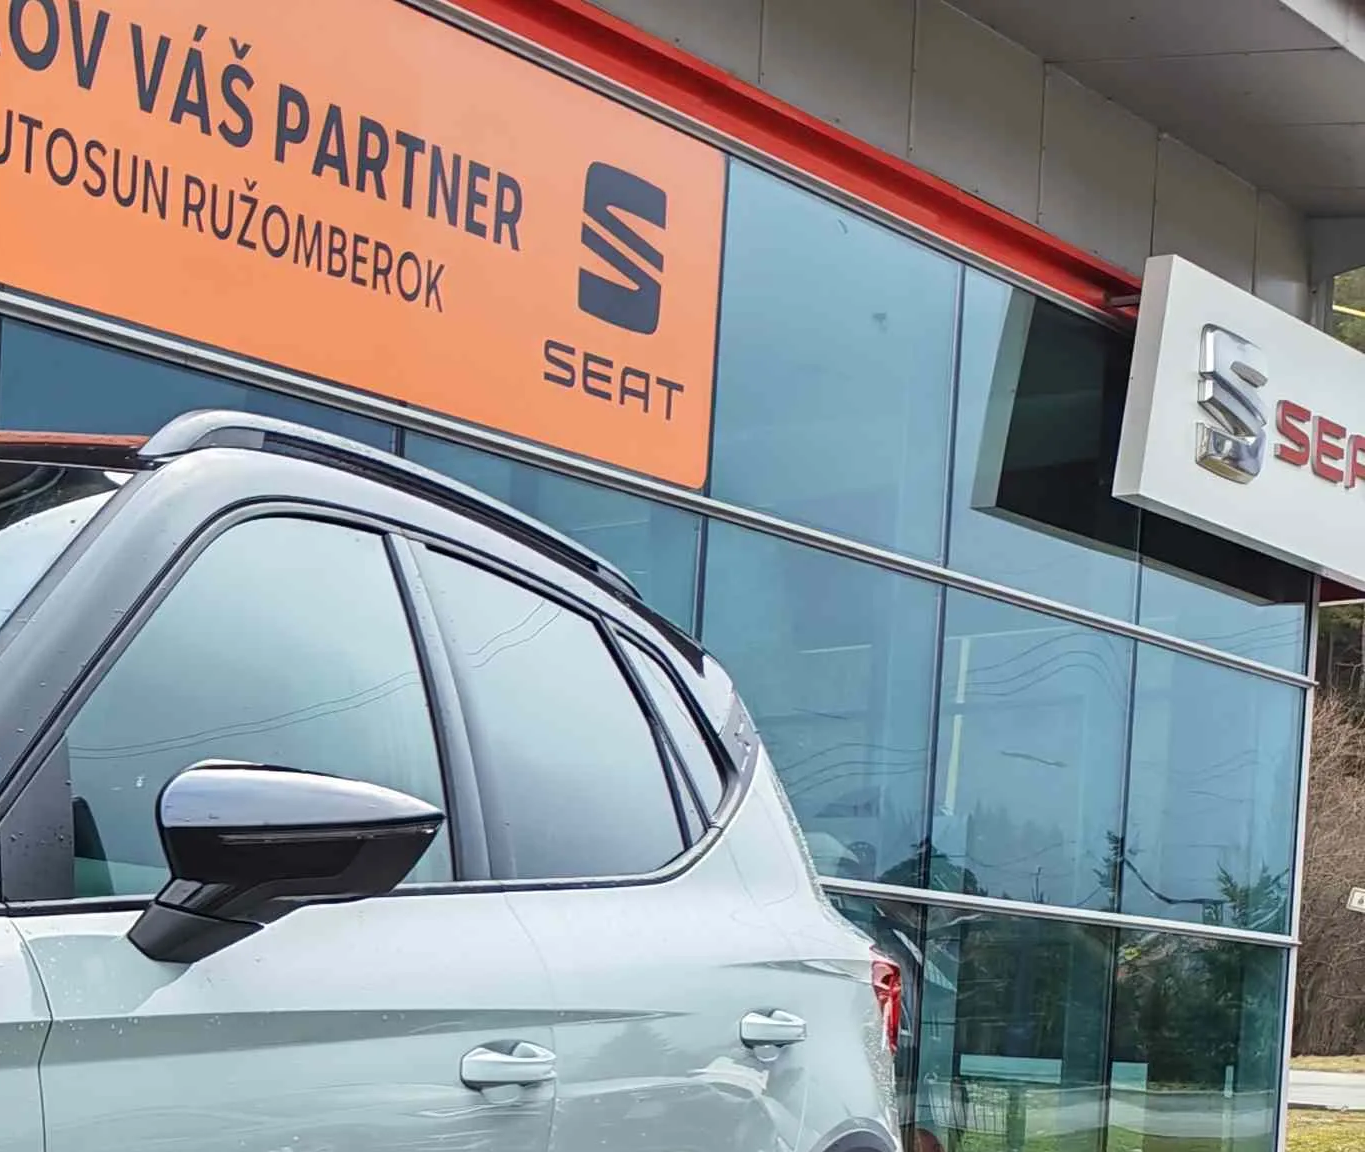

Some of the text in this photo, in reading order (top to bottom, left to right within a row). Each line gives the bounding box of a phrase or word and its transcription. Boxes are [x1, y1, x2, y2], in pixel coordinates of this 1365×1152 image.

[130, 22, 255, 148] VÁŠ
[274, 83, 523, 251] PARTNER
[182, 174, 445, 313] RUŽOMBEROK
[543, 339, 684, 421] SEAT
[1273, 399, 1365, 489] SEA
